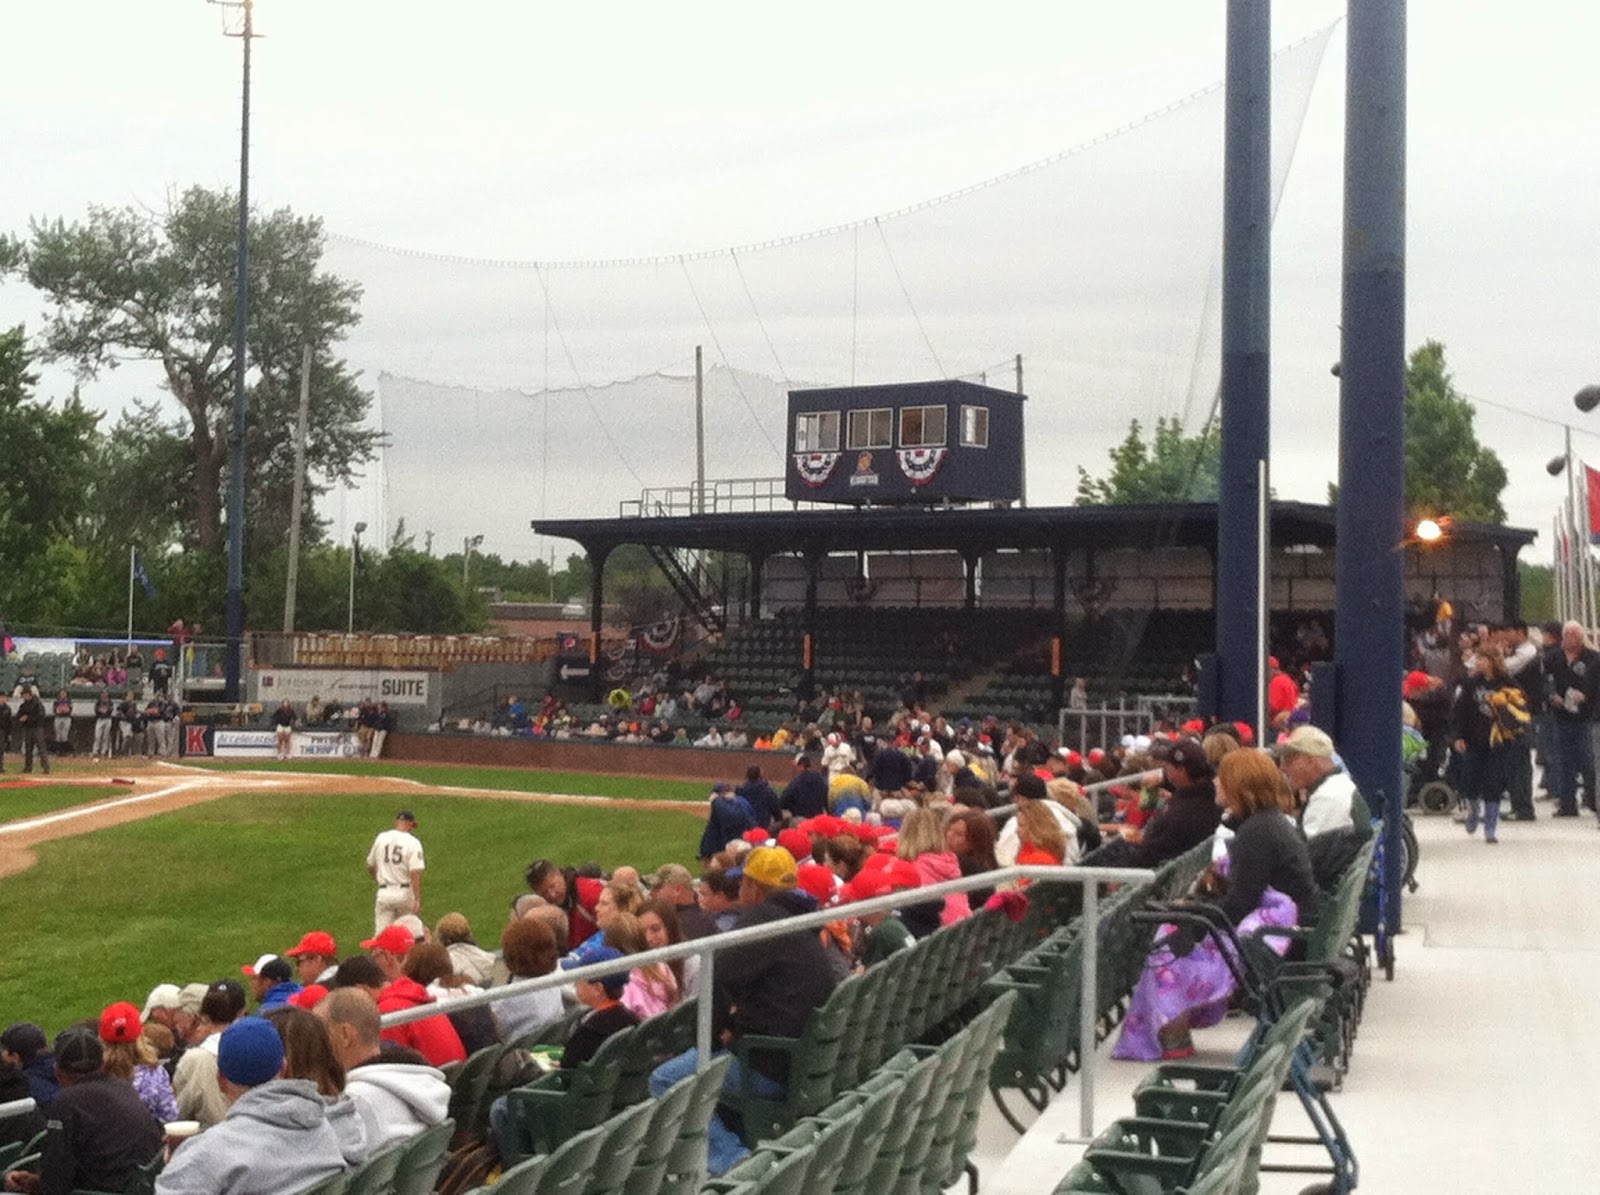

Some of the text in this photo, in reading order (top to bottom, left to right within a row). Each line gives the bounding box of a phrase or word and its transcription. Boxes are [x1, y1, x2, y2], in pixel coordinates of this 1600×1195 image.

[381, 678, 424, 696] SUITE
[186, 725, 208, 755] K
[384, 844, 403, 865] 15
